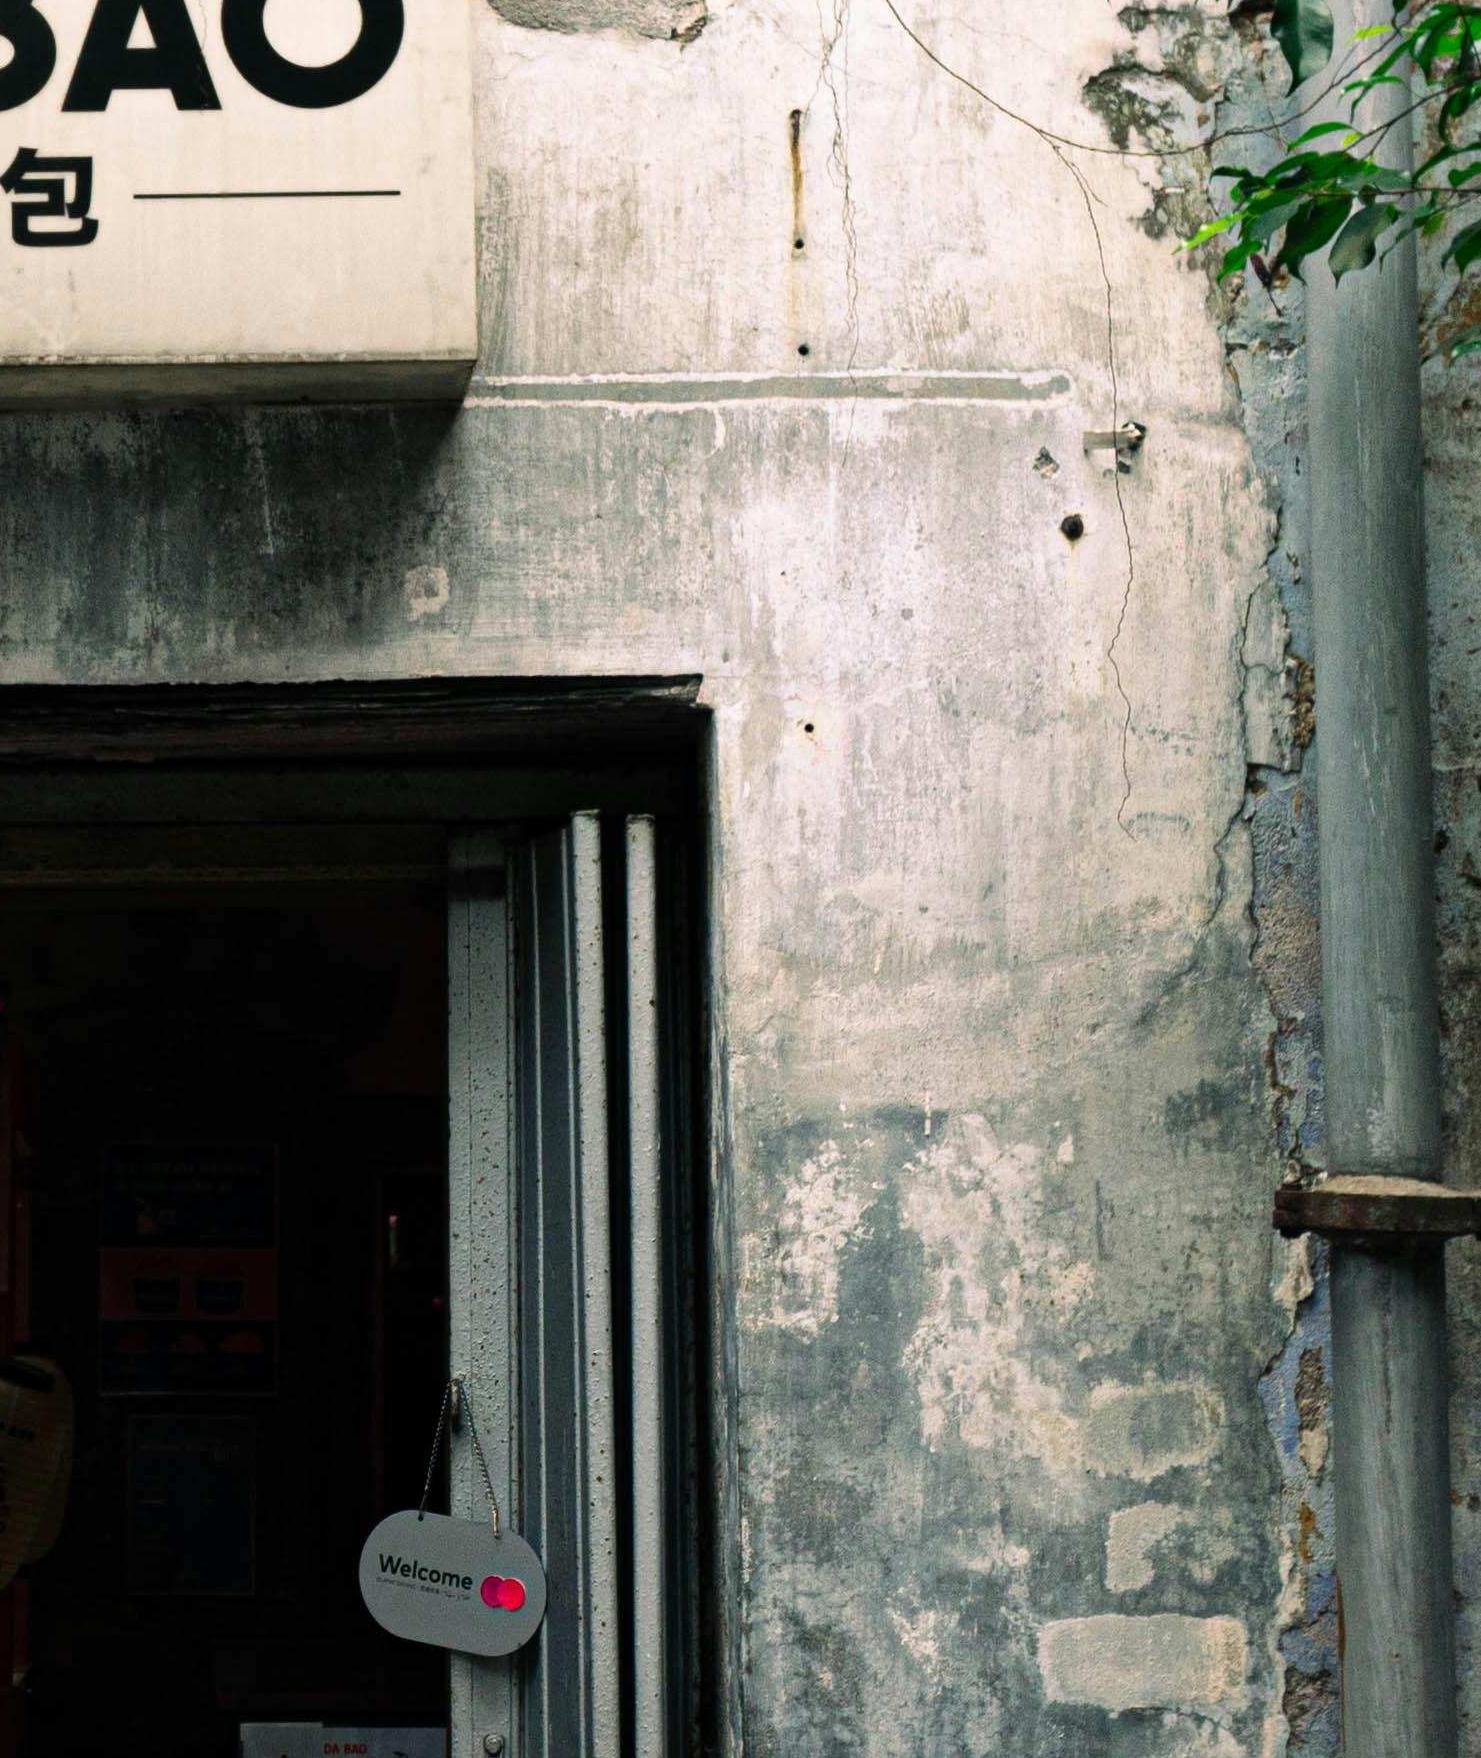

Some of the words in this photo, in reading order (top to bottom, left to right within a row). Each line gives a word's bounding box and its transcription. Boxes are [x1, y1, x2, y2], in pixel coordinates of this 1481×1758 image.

[378, 1553, 473, 1590] Welcome
[324, 1744, 340, 1754] DA
[344, 1744, 367, 1754] BAO
